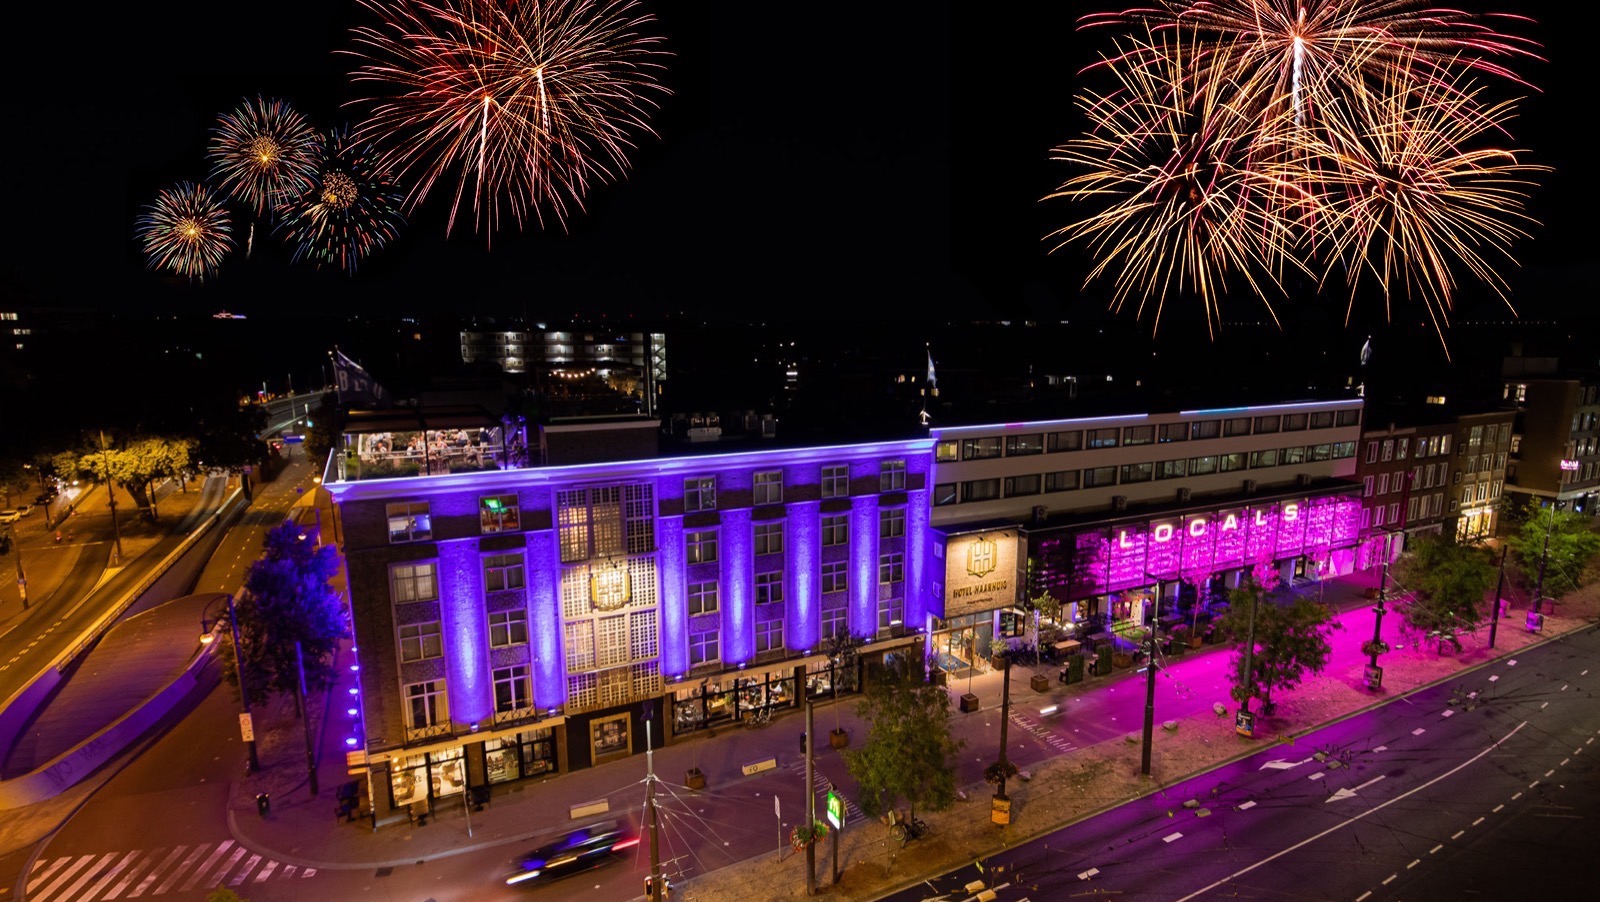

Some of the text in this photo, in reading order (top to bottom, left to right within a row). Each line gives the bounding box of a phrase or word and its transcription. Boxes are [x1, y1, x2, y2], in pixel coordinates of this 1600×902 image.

[1120, 504, 1298, 548] LOCALS
[953, 580, 1007, 598] HOTEL HAARHUIS
